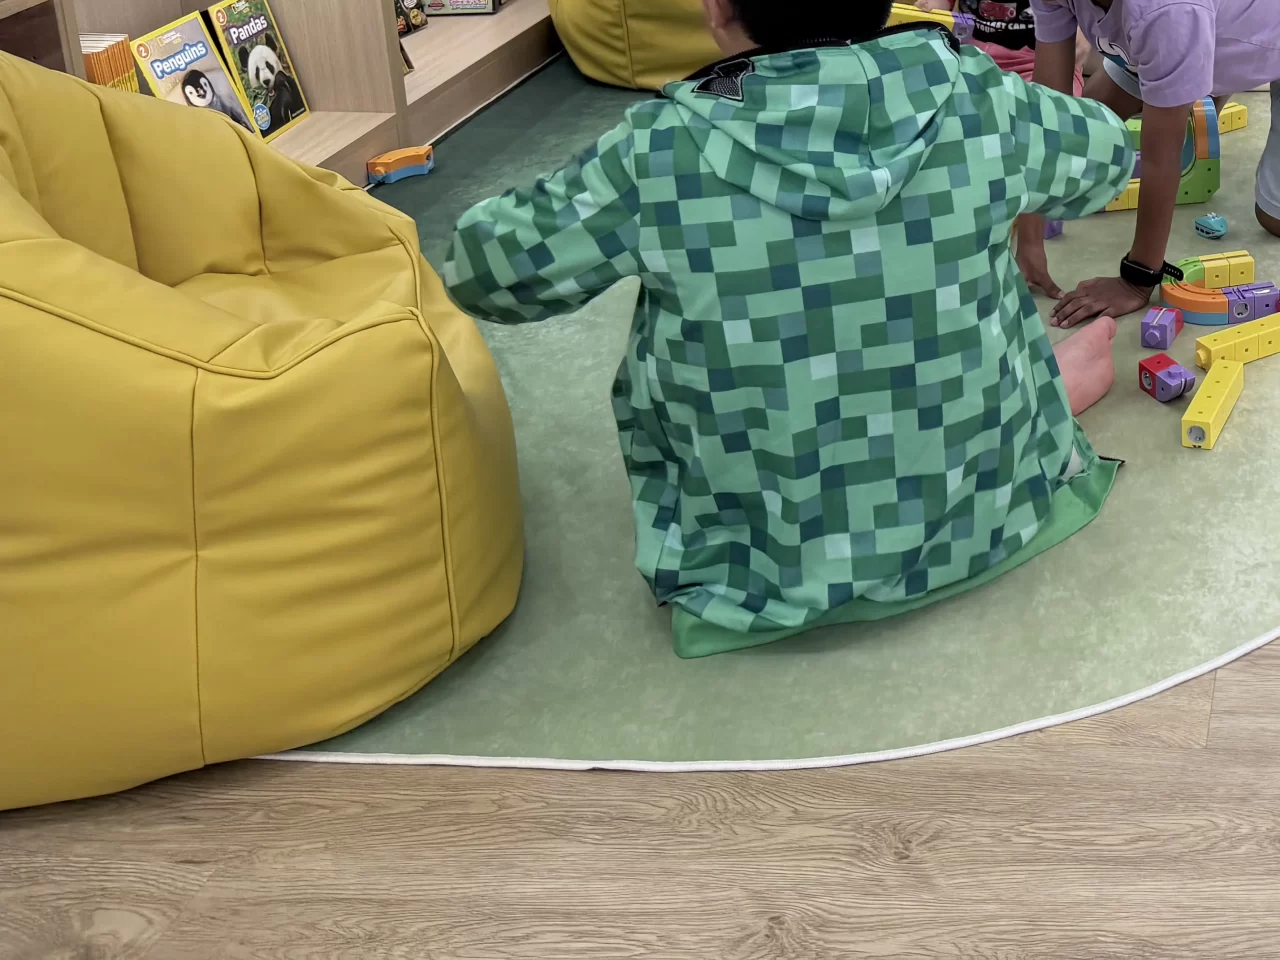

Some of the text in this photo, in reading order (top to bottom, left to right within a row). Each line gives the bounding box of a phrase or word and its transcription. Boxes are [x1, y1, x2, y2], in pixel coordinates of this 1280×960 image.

[218, 12, 224, 23] 2
[229, 14, 268, 45] Pandas
[139, 45, 147, 57] 2
[152, 41, 208, 79] Penguins
